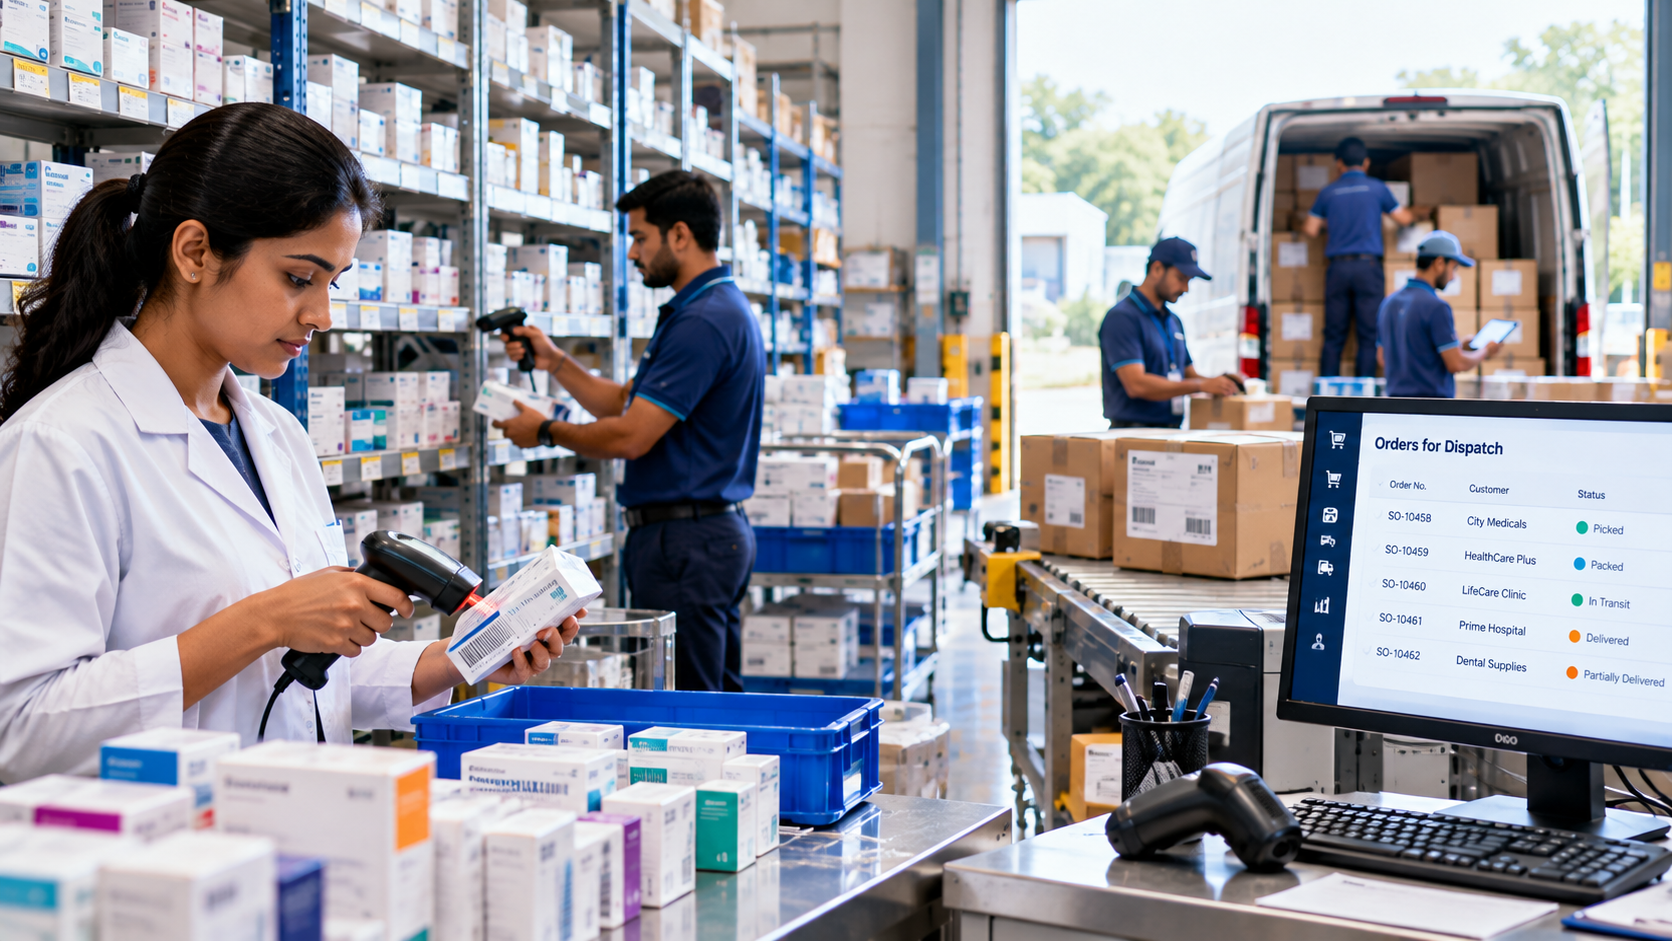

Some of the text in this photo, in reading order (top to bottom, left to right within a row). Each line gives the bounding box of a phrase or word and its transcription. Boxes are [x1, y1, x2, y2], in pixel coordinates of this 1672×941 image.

[1375, 437, 1503, 457] Orders for Dispatch
[1390, 479, 1427, 492] Order No.
[1469, 484, 1509, 494] Customer
[1578, 489, 1605, 499] Status
[1388, 511, 1431, 523] SO-10458
[1467, 516, 1527, 529] City Medicals
[1594, 524, 1624, 535] Picked
[1385, 544, 1429, 557] SO-10459
[1465, 551, 1536, 565] HealthCare Plus
[1591, 560, 1623, 571] Packed
[1382, 579, 1426, 591] SO-10460
[1462, 585, 1526, 600] LifeCare Clinic
[1589, 597, 1630, 609] In Transit
[1379, 613, 1422, 625] SO-10461
[1459, 620, 1526, 636] Prime Hospital
[1587, 633, 1629, 646] Delivered
[1376, 647, 1420, 660] SO-10462
[1457, 655, 1527, 672] Dental Supplies
[1584, 670, 1665, 687] Partially Delivered
